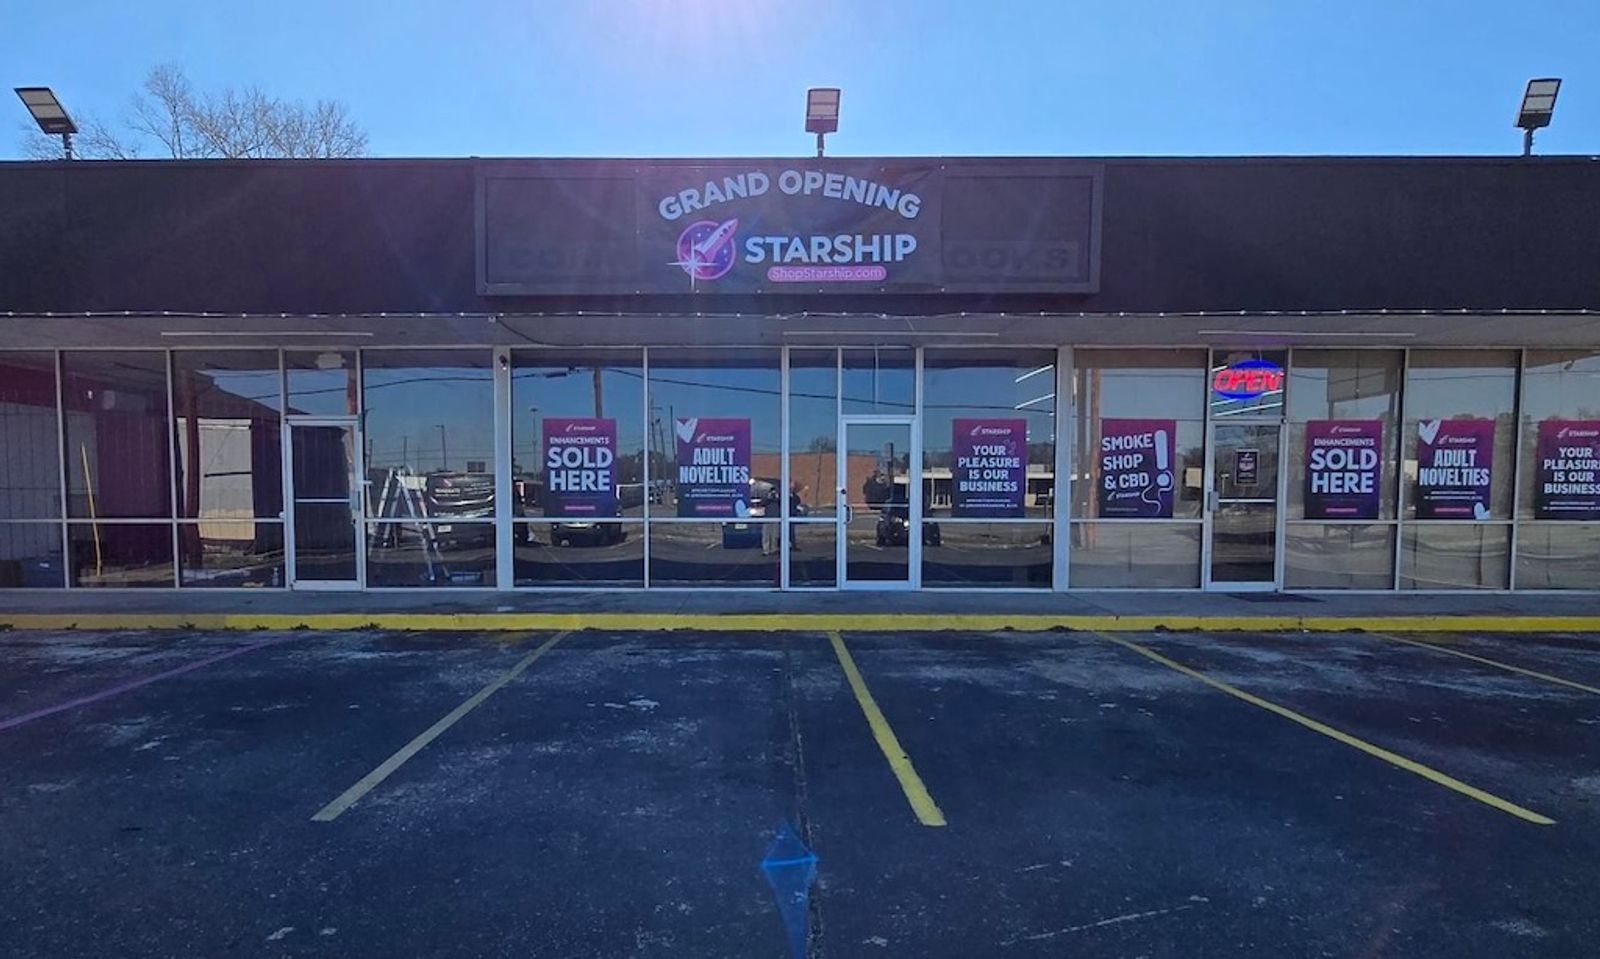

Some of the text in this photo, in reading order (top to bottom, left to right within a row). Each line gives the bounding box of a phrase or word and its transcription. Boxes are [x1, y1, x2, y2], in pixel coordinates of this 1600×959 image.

[659, 169, 921, 221] GRAND OPENING
[745, 234, 917, 263] STARSHIP
[772, 268, 882, 280] ShopStarship.com
[1214, 368, 1284, 392] OPEN
[549, 437, 610, 445] ENHANCEMENTS
[972, 445, 1007, 455] YOUR
[1102, 433, 1153, 451] SMOKE
[1313, 438, 1375, 446] ENHANCEMENTS
[547, 446, 613, 468] SOLD
[693, 447, 735, 465] ADULT
[1103, 453, 1144, 470] SHOP
[1309, 448, 1378, 470] SOLD
[1434, 449, 1477, 467] ADULT
[1559, 447, 1593, 458] YOUR
[958, 457, 1020, 468] PLEASURE
[1543, 459, 1600, 470] PLEASUR
[549, 470, 611, 491] HERE
[680, 466, 749, 484] NOVELTIES
[968, 469, 1009, 479] IS OUR
[1104, 472, 1150, 490] & CBD
[1311, 472, 1374, 493] HERE
[1419, 468, 1489, 486] NOVELTIES
[1553, 471, 1595, 481] IS OUR
[959, 481, 1018, 492] BUSINESS
[1544, 483, 1600, 494] BUSINESS
